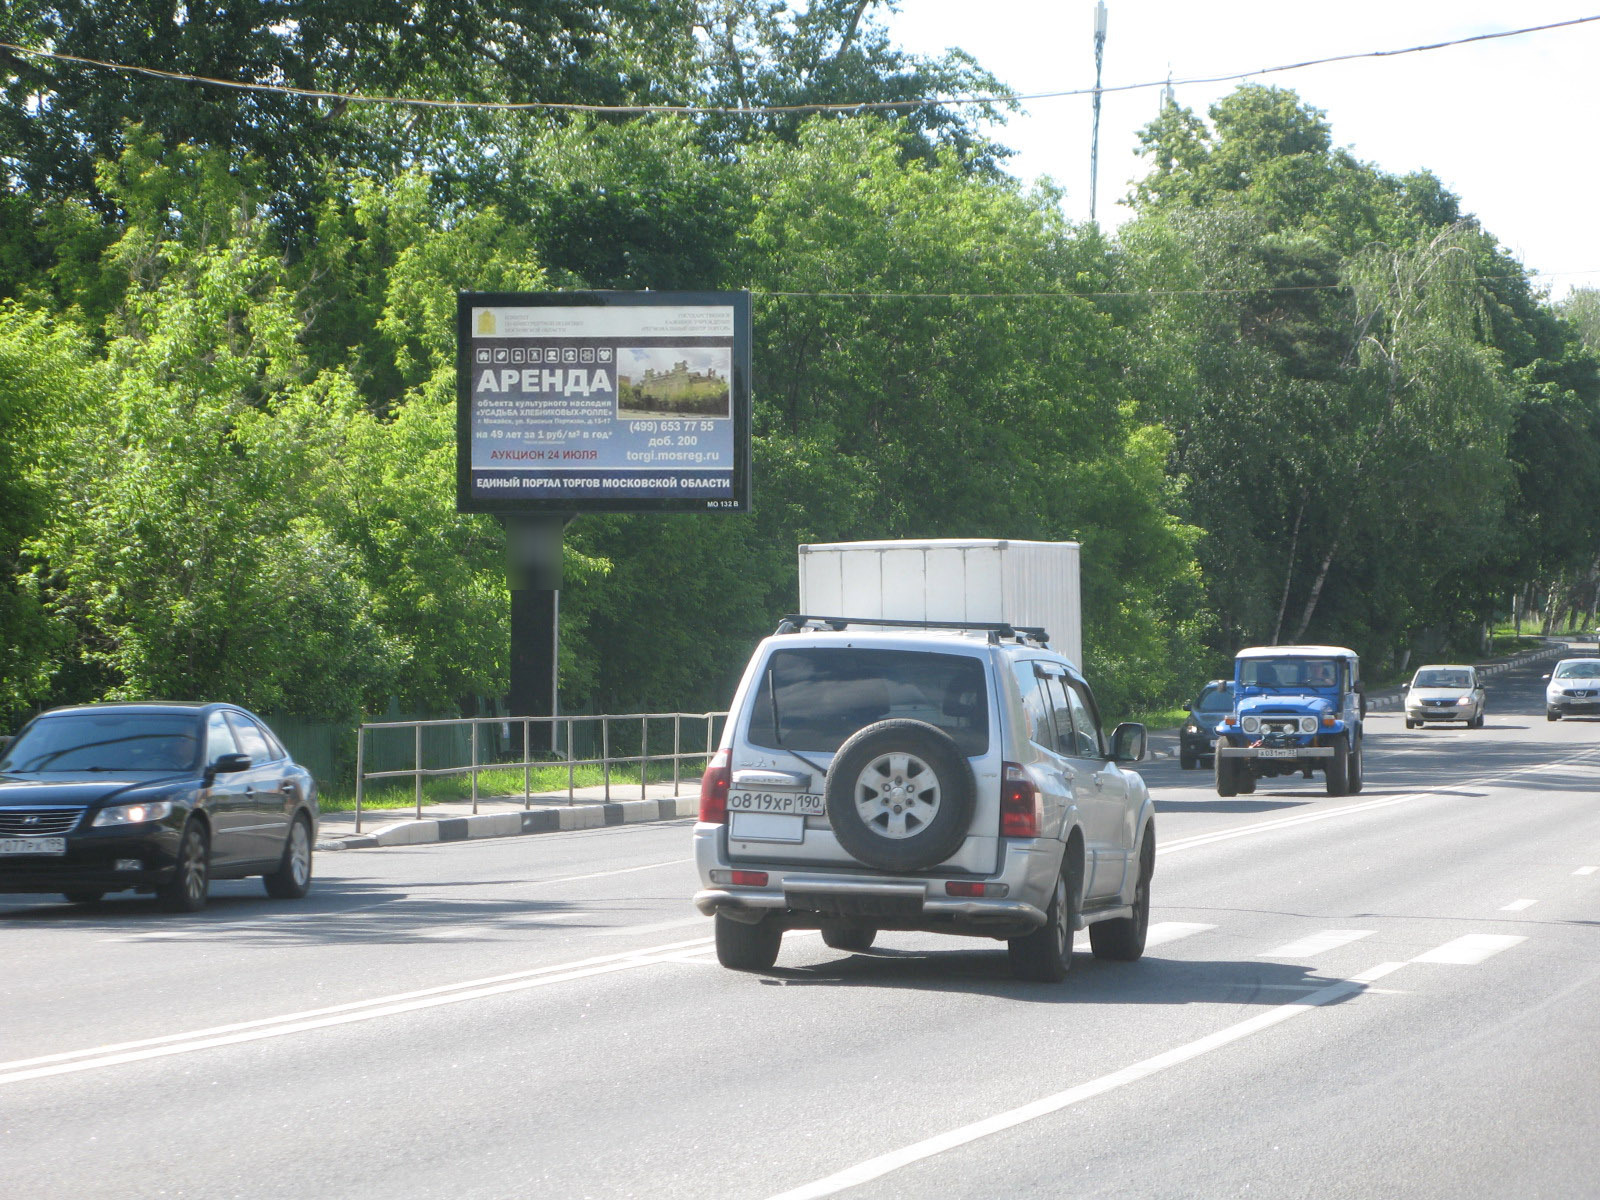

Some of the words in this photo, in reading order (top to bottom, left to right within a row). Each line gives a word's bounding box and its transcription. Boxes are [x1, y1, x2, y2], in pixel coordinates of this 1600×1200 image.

[476, 369, 612, 396] АРЕНДА
[477, 400, 513, 408] объекта
[515, 400, 567, 409] культурного
[569, 400, 612, 408] наследия
[476, 431, 488, 439] на
[490, 429, 504, 439] 49
[505, 431, 522, 439] лет
[524, 431, 536, 439] за
[537, 429, 545, 439] 1
[582, 431, 590, 439] в
[629, 421, 658, 435] (499)
[660, 421, 681, 432] 653
[683, 421, 697, 432] 77
[700, 421, 715, 432] 55
[648, 436, 675, 447] доб.
[677, 436, 698, 447] 200
[490, 450, 545, 460] АУКЦИОН
[547, 450, 560, 460] 24
[562, 450, 598, 460] ИЮЛЯ
[626, 450, 720, 463] torgi.mosreg.ru
[476, 476, 521, 489] ЕДИНЫЙ
[522, 478, 562, 488] ПОРТАЛ
[562, 478, 601, 488] ТОРГОВ
[602, 476, 678, 488] МОСКОВСКОЙ
[680, 478, 730, 488] ОБЛАСТИ
[731, 793, 792, 811] О819ХР
[797, 795, 820, 808] 190
